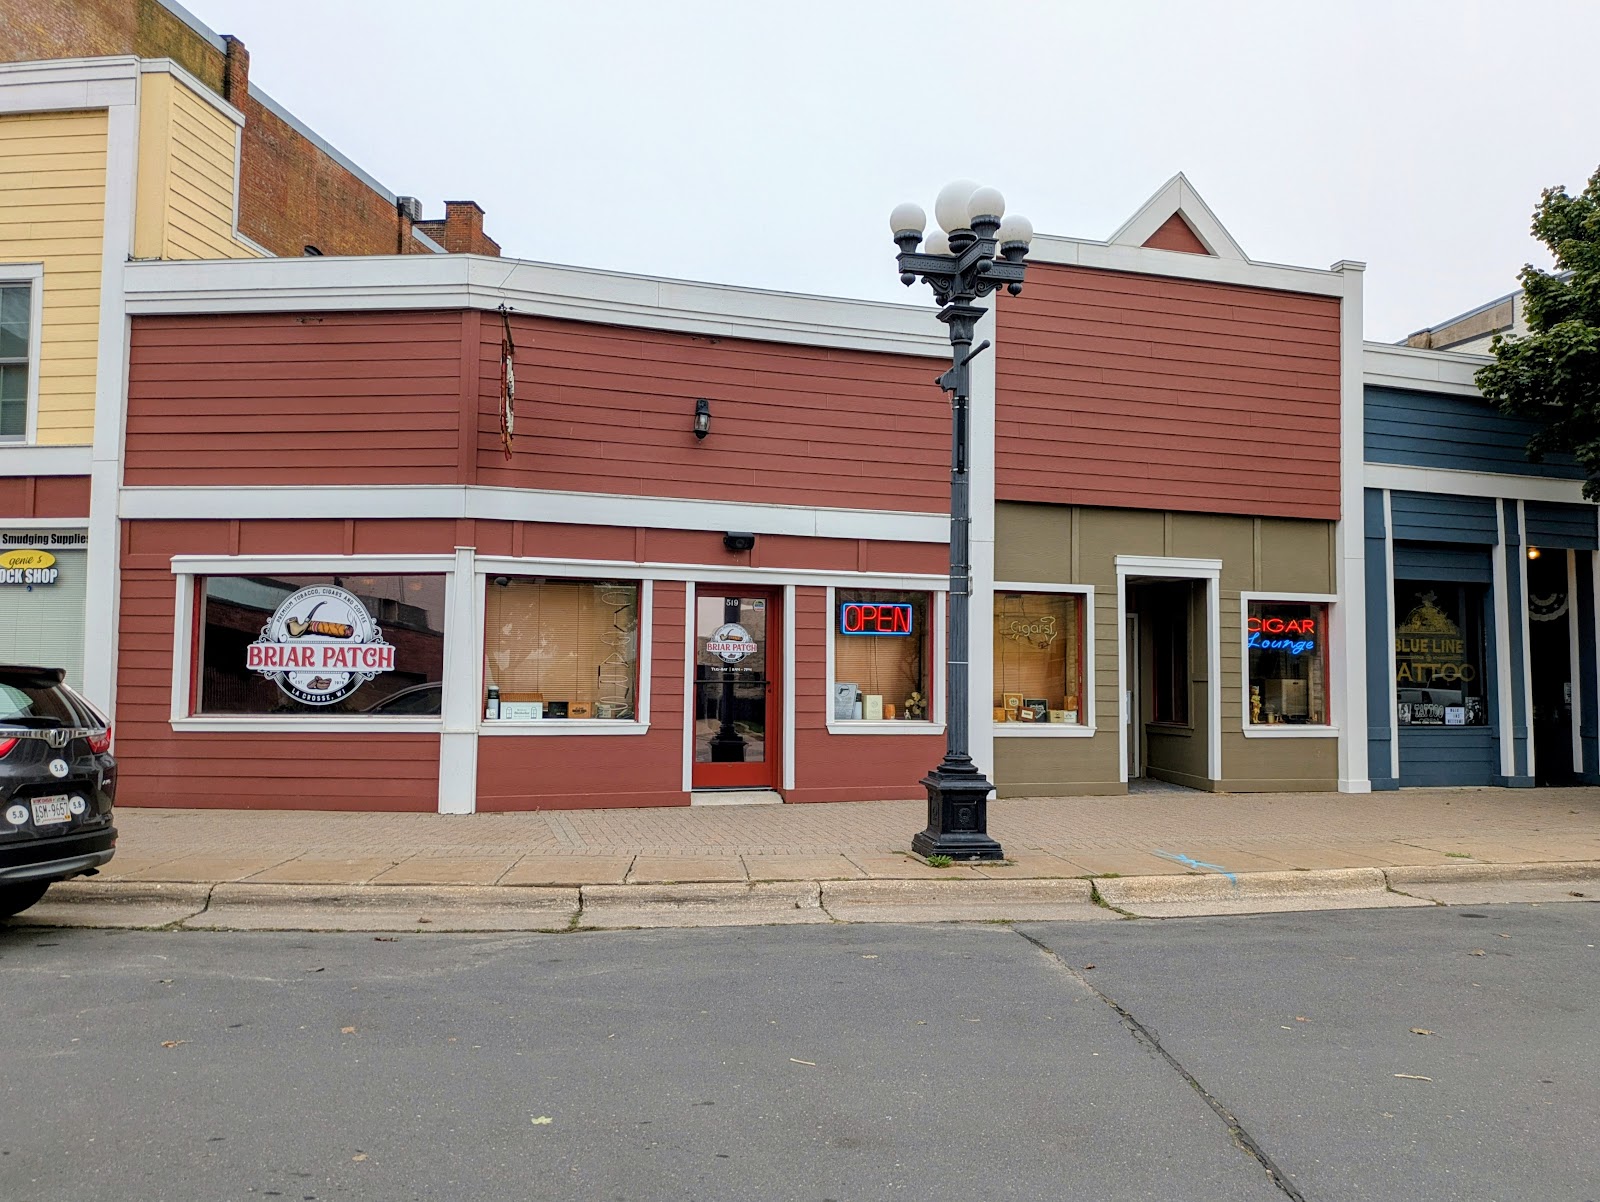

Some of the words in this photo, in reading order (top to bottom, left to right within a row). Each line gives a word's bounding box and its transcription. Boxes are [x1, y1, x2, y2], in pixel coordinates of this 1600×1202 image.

[2, 533, 49, 545] Smudging
[0, 568, 23, 584] OCK
[25, 568, 58, 584] SHOP
[276, 600, 294, 623] PREMIUM
[322, 588, 343, 599] CIGARS
[343, 595, 354, 606] AND
[353, 604, 367, 624] COFFEE
[844, 605, 911, 633] OPEN
[1248, 617, 1315, 634] CIGAR
[1010, 620, 1050, 637] Cigars
[707, 643, 731, 651] BRIAR
[732, 643, 757, 652] PATCH
[1248, 632, 1314, 655] Lounge
[1396, 638, 1429, 653] BLUE
[1432, 639, 1464, 654] LINE
[248, 646, 316, 667] BRIAR
[322, 646, 394, 669] PATCH
[1396, 662, 1476, 682] ATTOO
[291, 688, 300, 697] LA
[335, 688, 346, 697] WI
[54, 764, 64, 772] 5.8
[12, 811, 23, 819] 5.8
